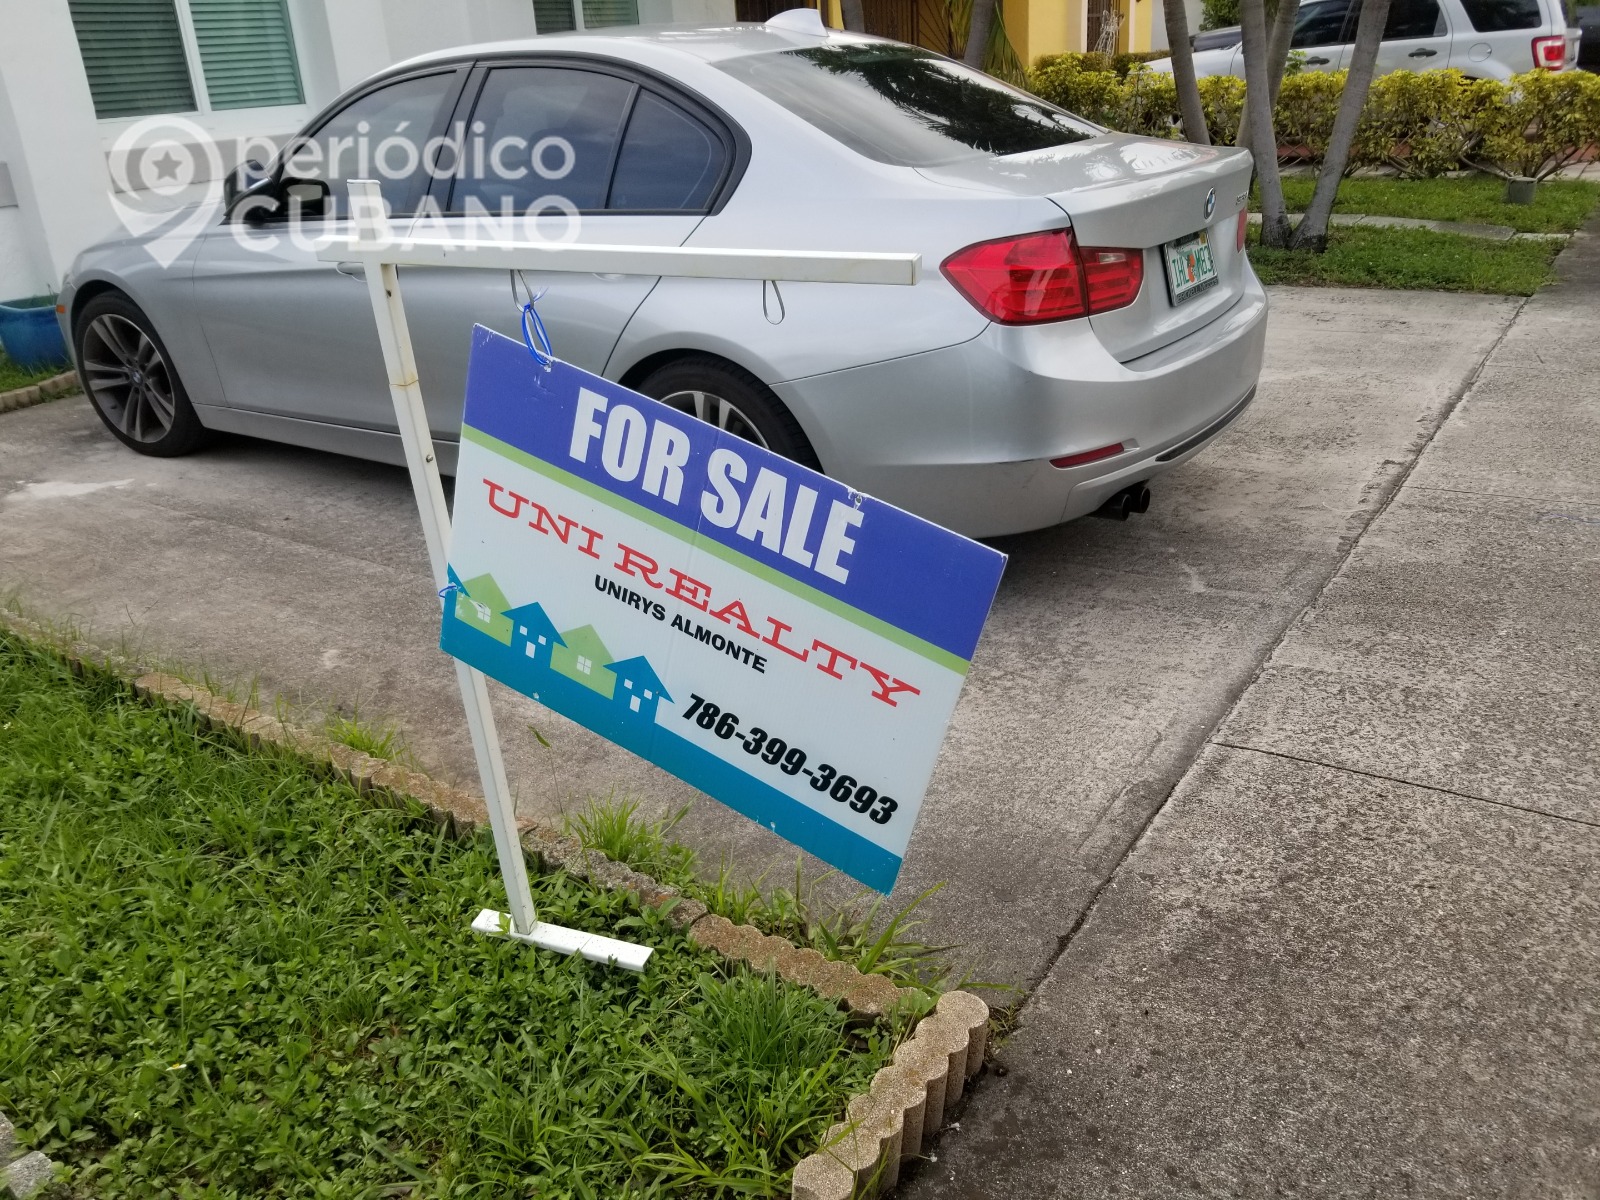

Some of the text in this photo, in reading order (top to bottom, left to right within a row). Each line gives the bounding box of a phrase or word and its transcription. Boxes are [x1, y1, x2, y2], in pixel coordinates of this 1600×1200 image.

[569, 386, 865, 585] FOR SALE
[483, 479, 921, 708] UNI REALTY
[595, 574, 768, 674] UNIRYS ALMONTE
[682, 692, 899, 825] 786-399-3693
